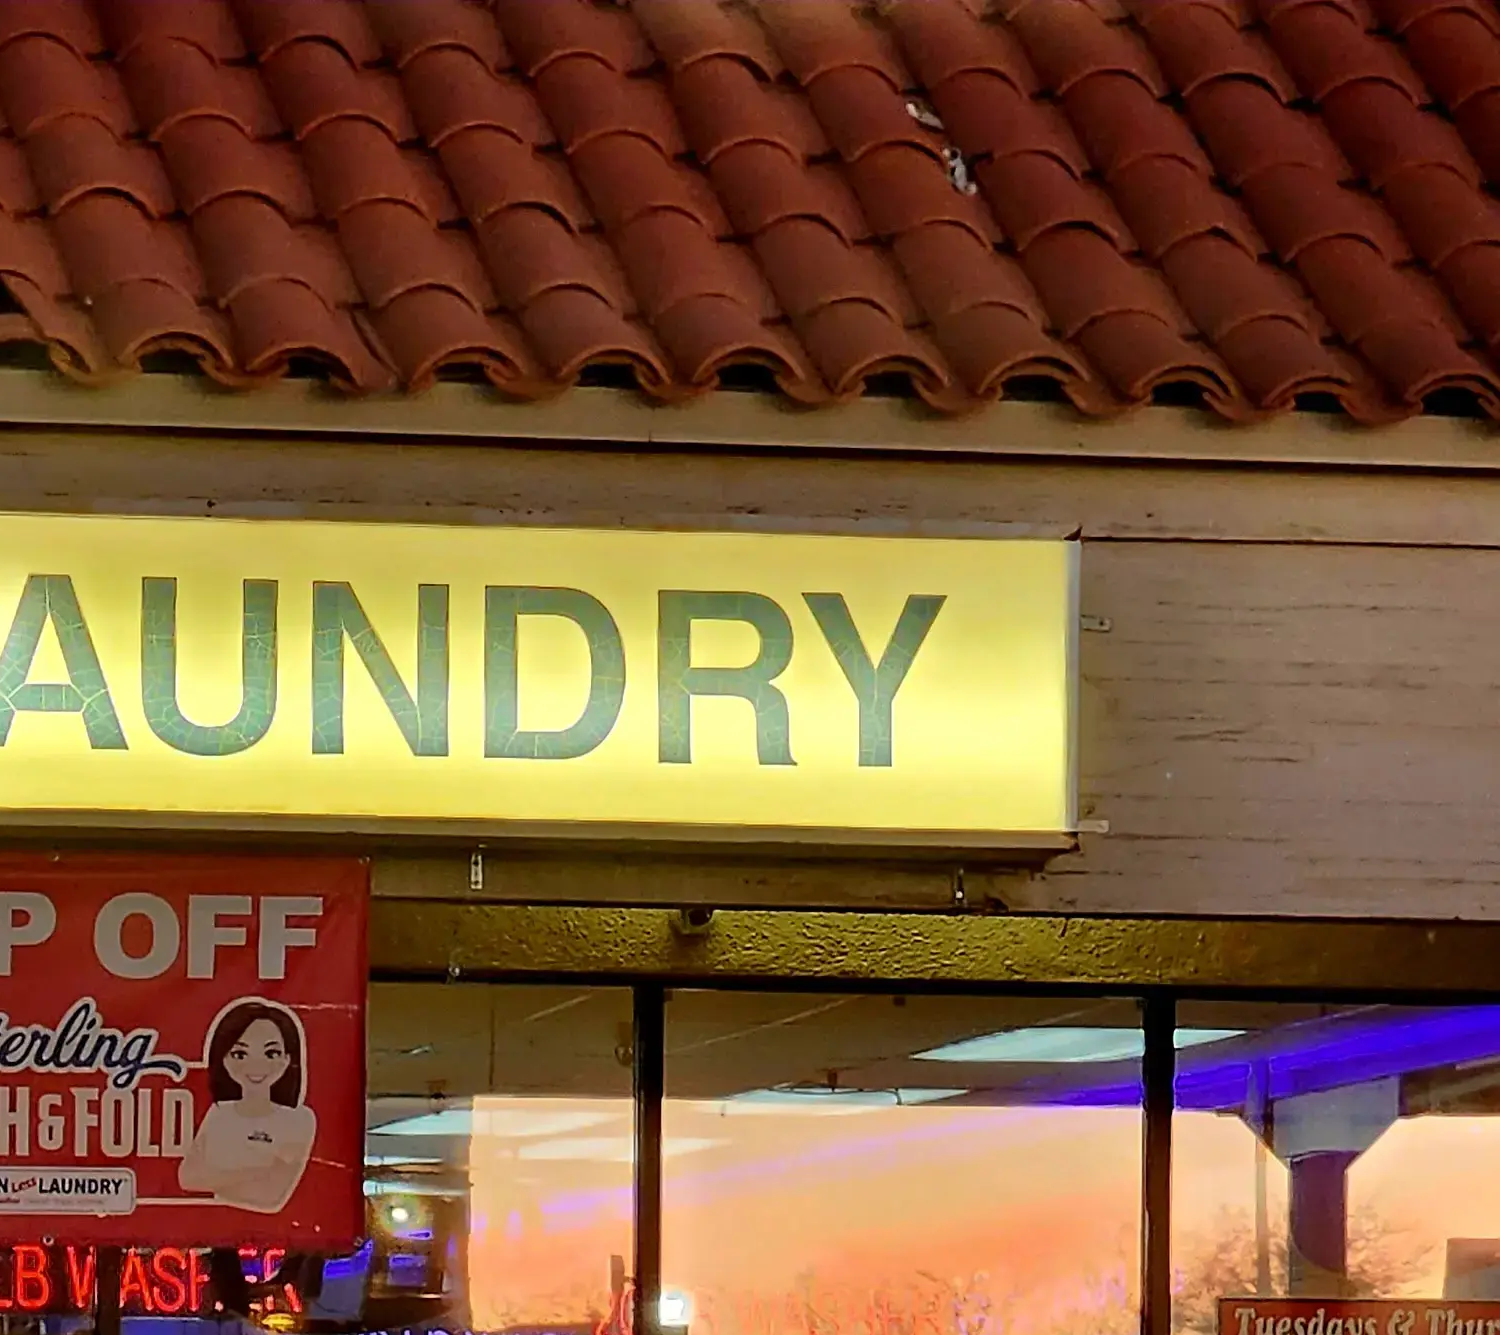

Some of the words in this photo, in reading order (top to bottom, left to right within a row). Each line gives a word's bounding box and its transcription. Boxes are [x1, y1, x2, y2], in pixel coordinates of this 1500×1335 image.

[93, 892, 325, 980] OFF
[72, 1086, 195, 1158] FOLD
[38, 1177, 123, 1195] LAUNDRY
